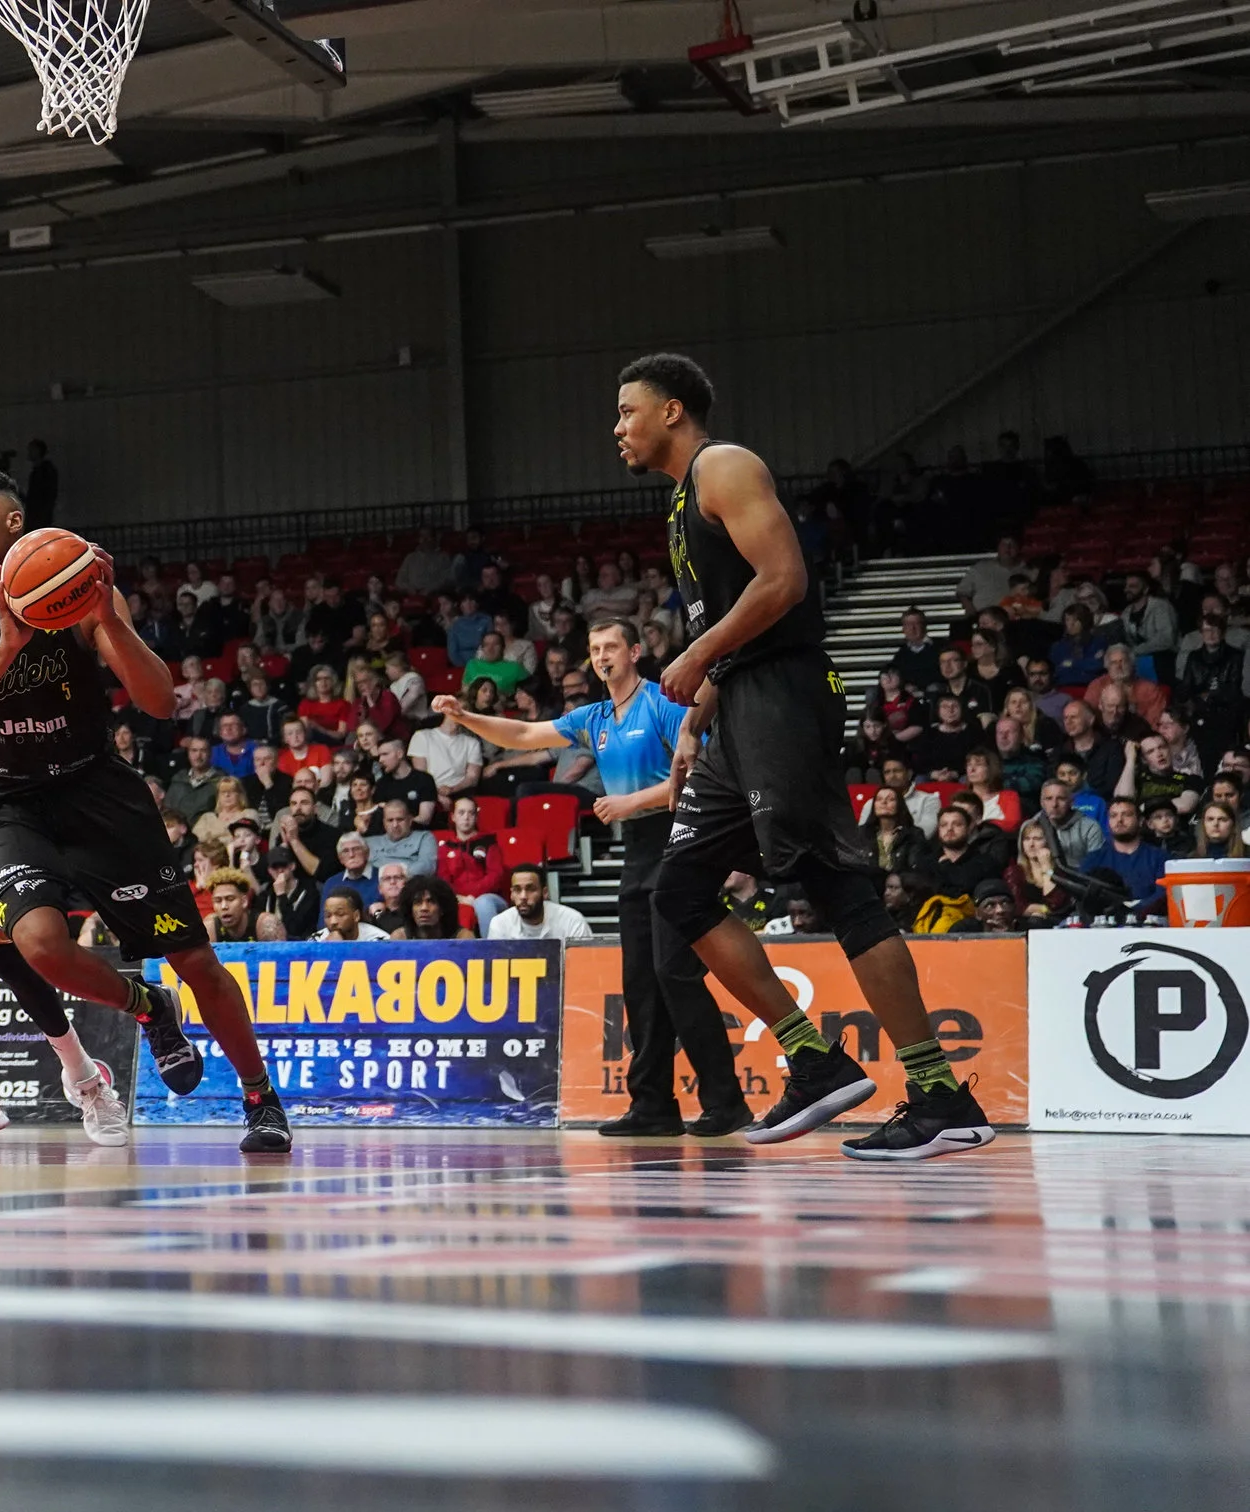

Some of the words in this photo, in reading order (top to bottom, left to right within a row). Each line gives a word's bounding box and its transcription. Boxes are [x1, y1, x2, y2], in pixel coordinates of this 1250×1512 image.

[46, 575, 95, 614] molten
[61, 682, 71, 701] 5
[0, 715, 68, 736] Jelson
[1134, 970, 1207, 1070] P
[388, 1037, 486, 1058] HOME
[502, 1037, 547, 1058] OF
[338, 1059, 451, 1089] SPORT
[344, 1105, 360, 1117] sky
